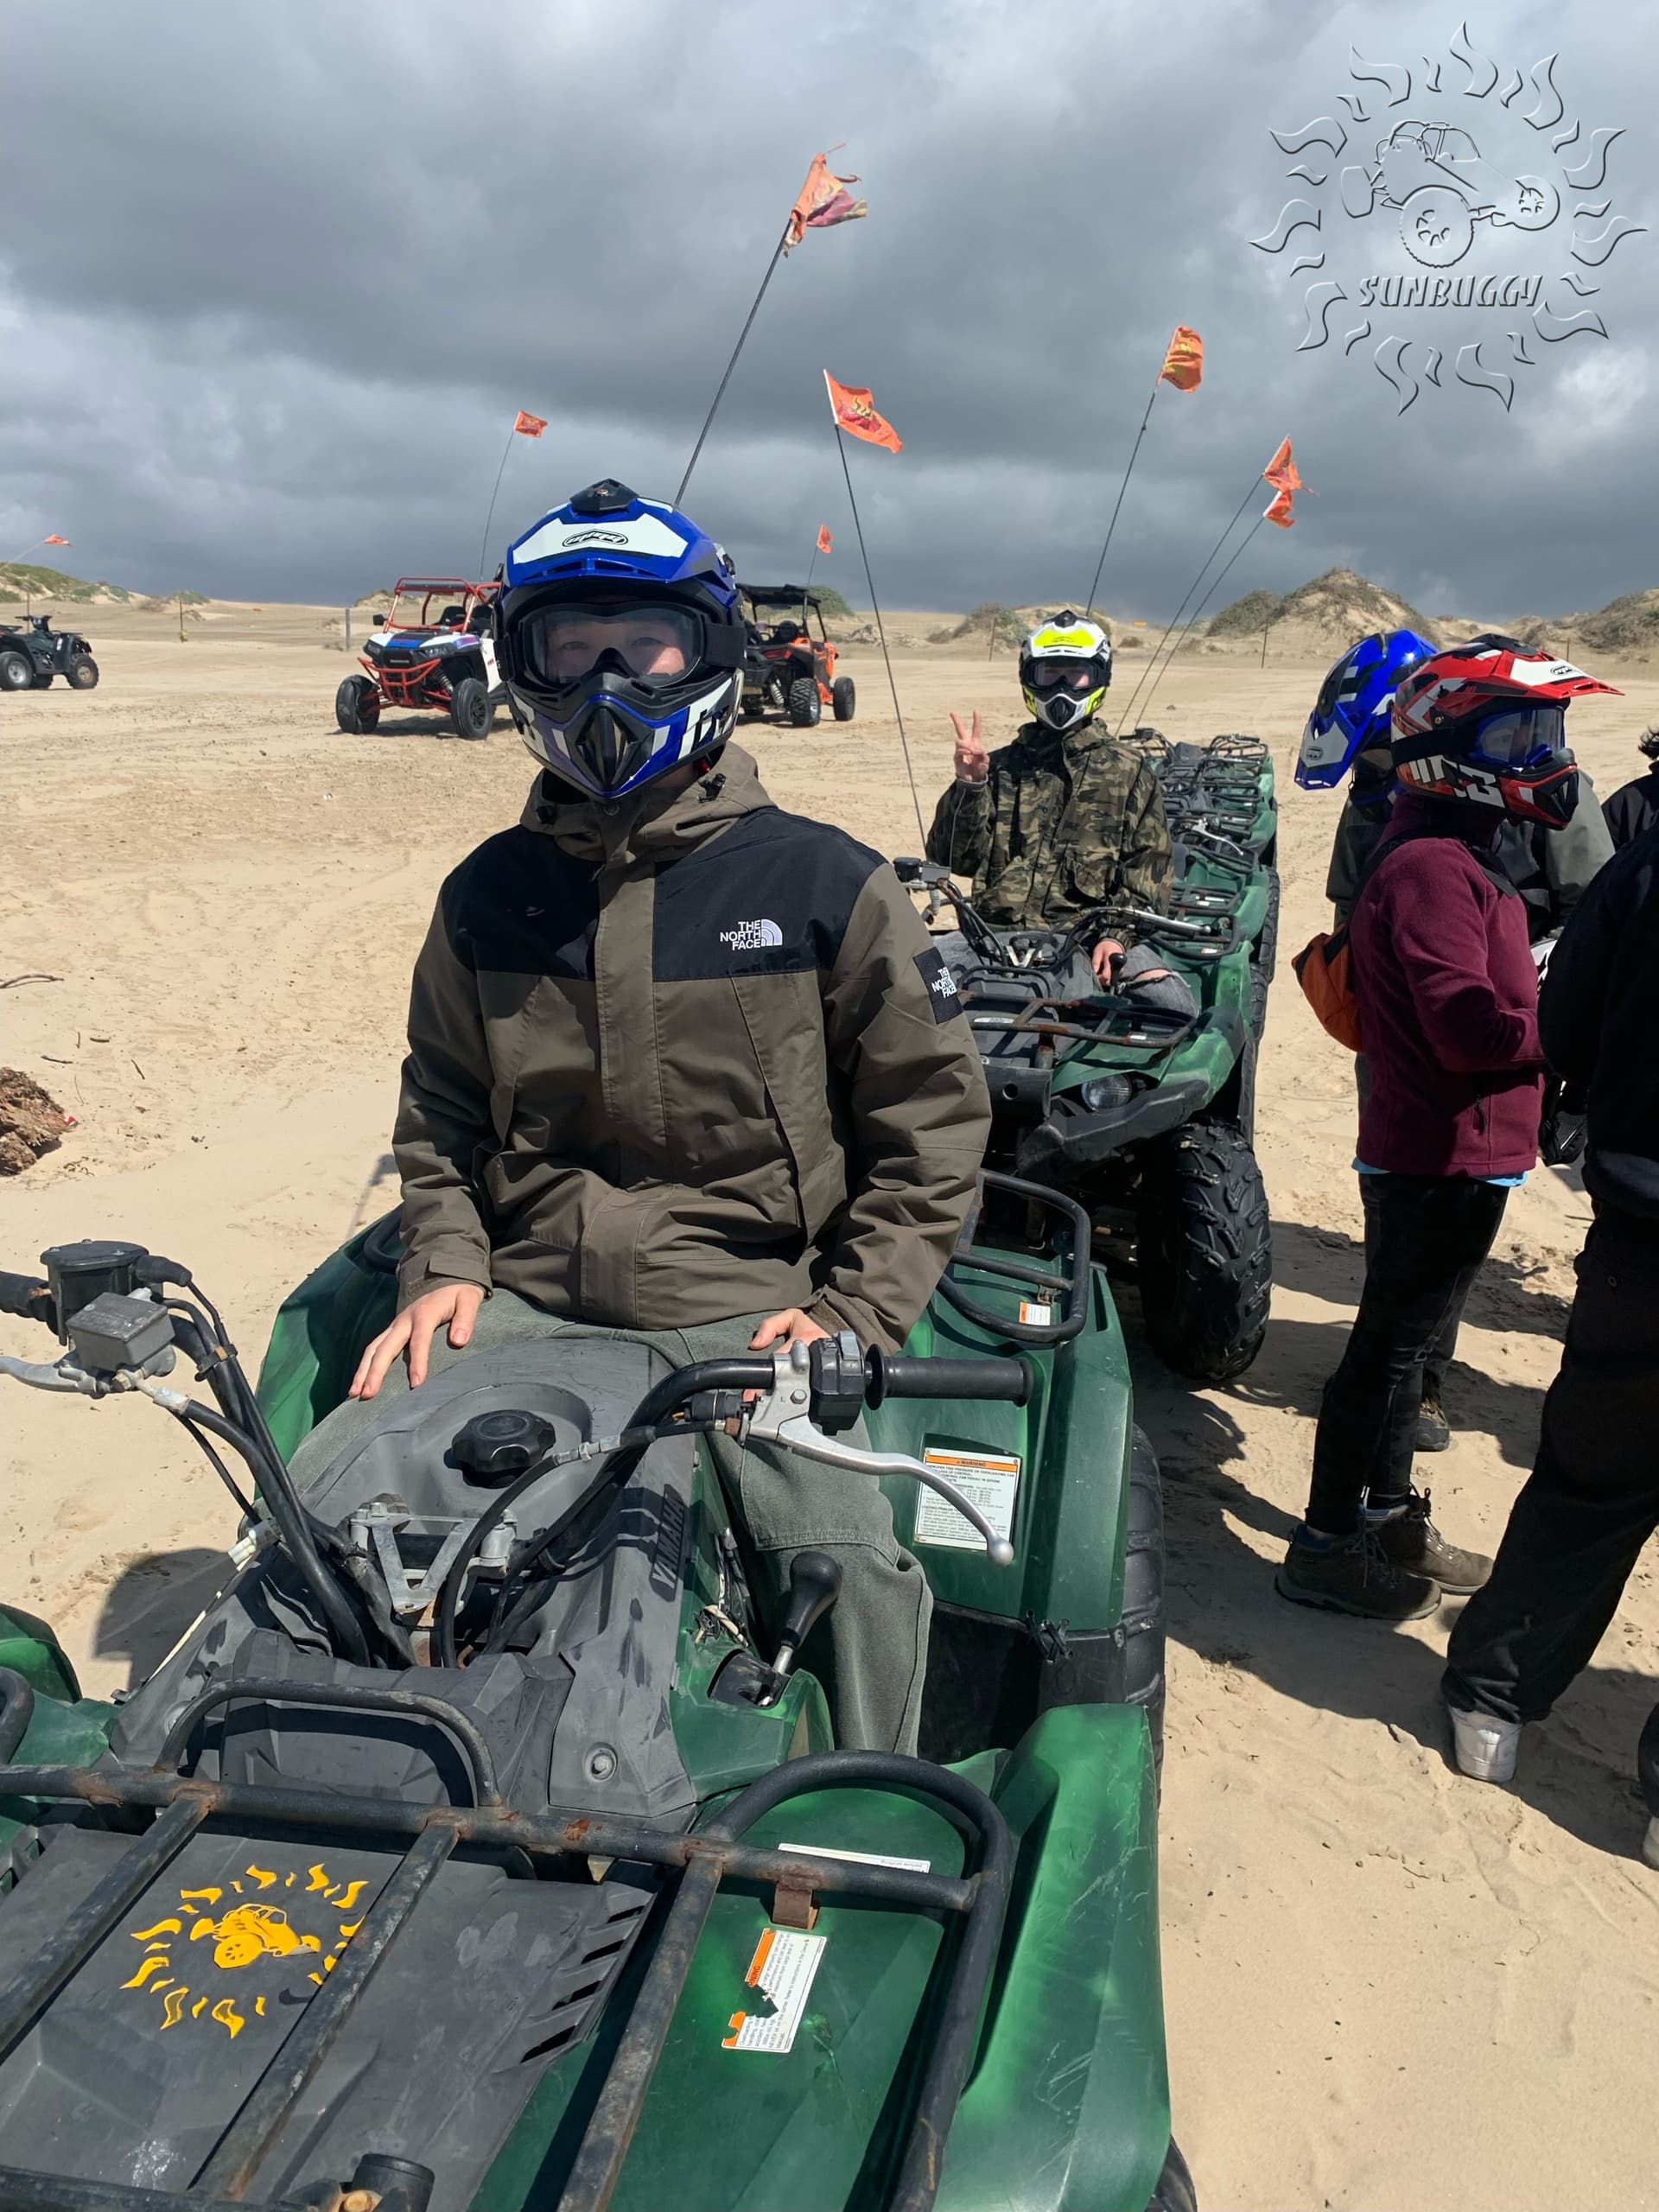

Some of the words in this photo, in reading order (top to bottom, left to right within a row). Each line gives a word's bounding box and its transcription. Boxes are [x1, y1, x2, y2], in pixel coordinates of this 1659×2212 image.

[738, 919, 760, 931] THE
[720, 930, 760, 942] NORTH
[732, 938, 760, 950] FACE
[938, 967, 950, 977] THE
[652, 1497, 683, 1589] YAMAHA
